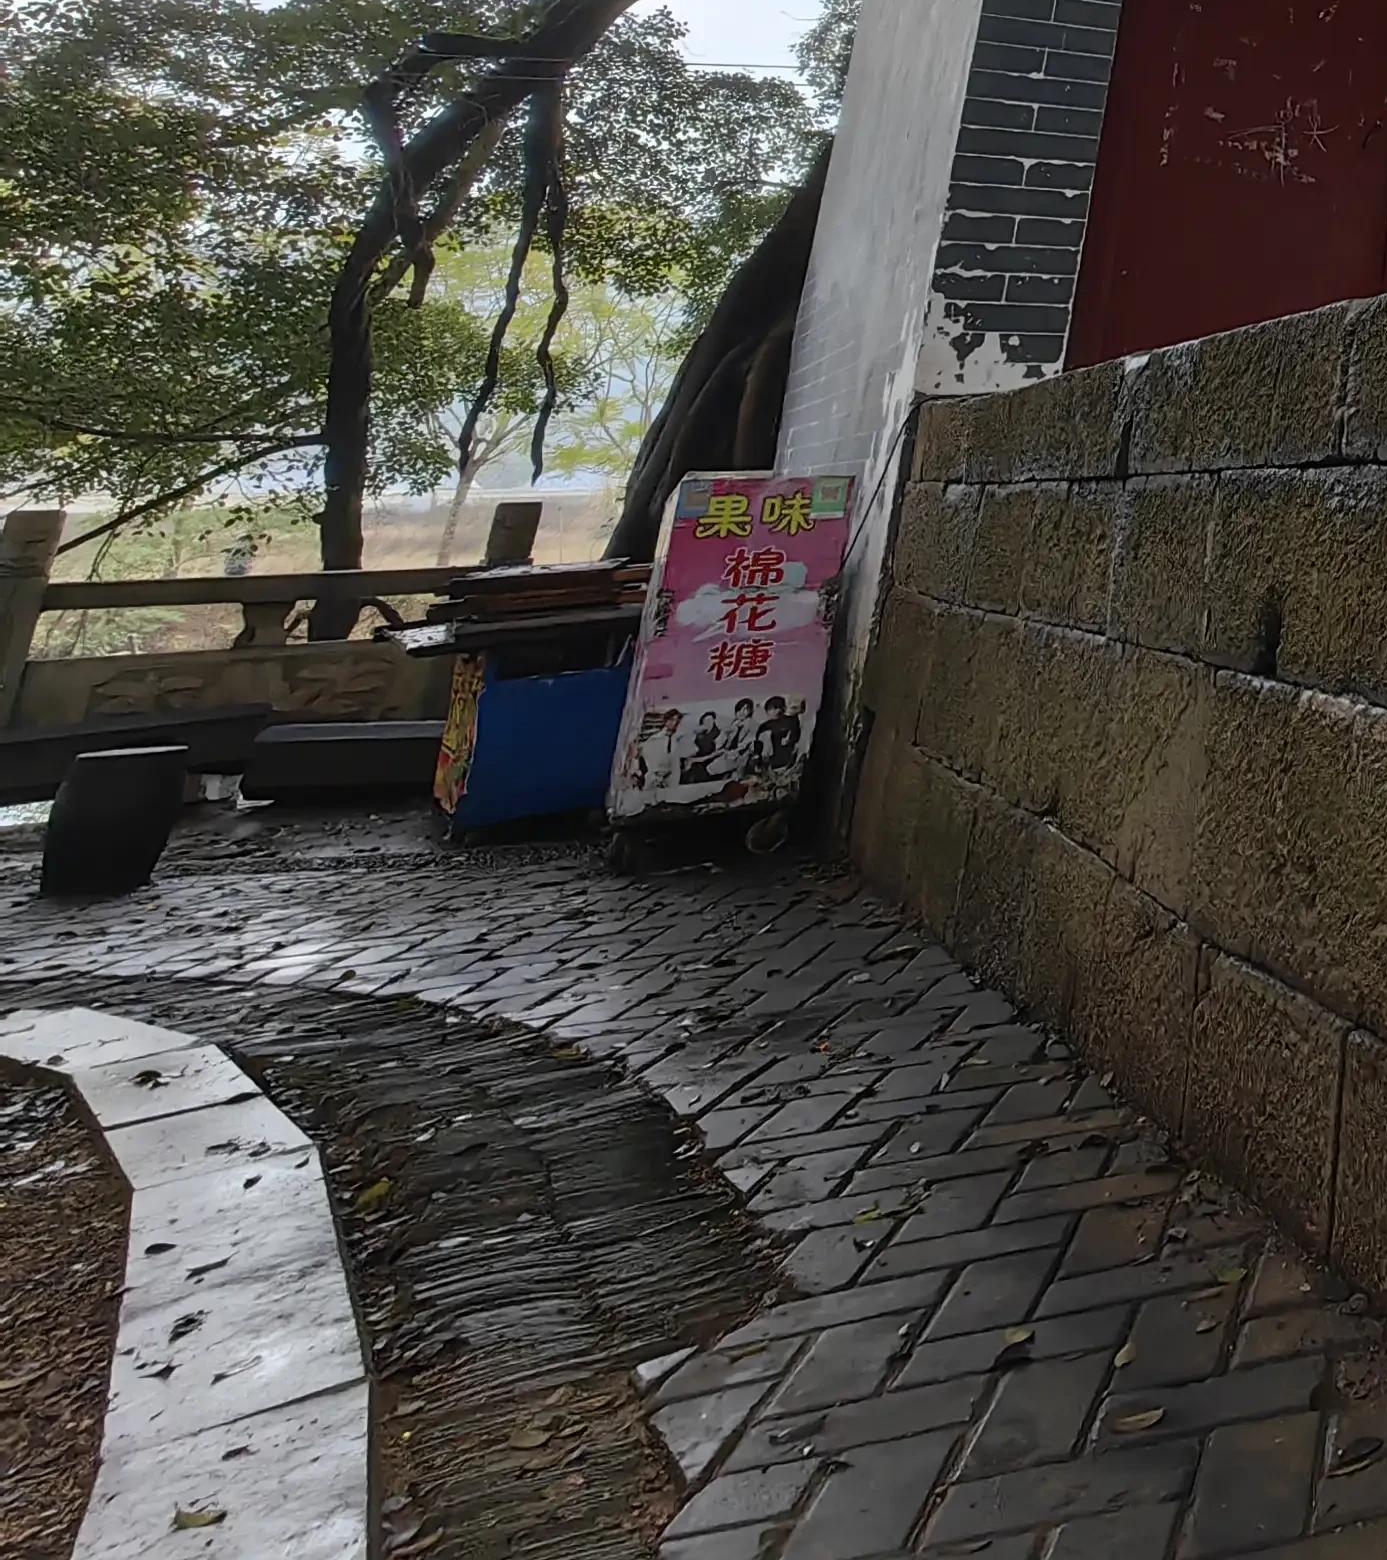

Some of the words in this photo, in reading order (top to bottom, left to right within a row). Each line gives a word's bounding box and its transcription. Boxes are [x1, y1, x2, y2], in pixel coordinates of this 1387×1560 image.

[694, 491, 814, 538] 果味
[706, 547, 786, 681] 棉花糖
